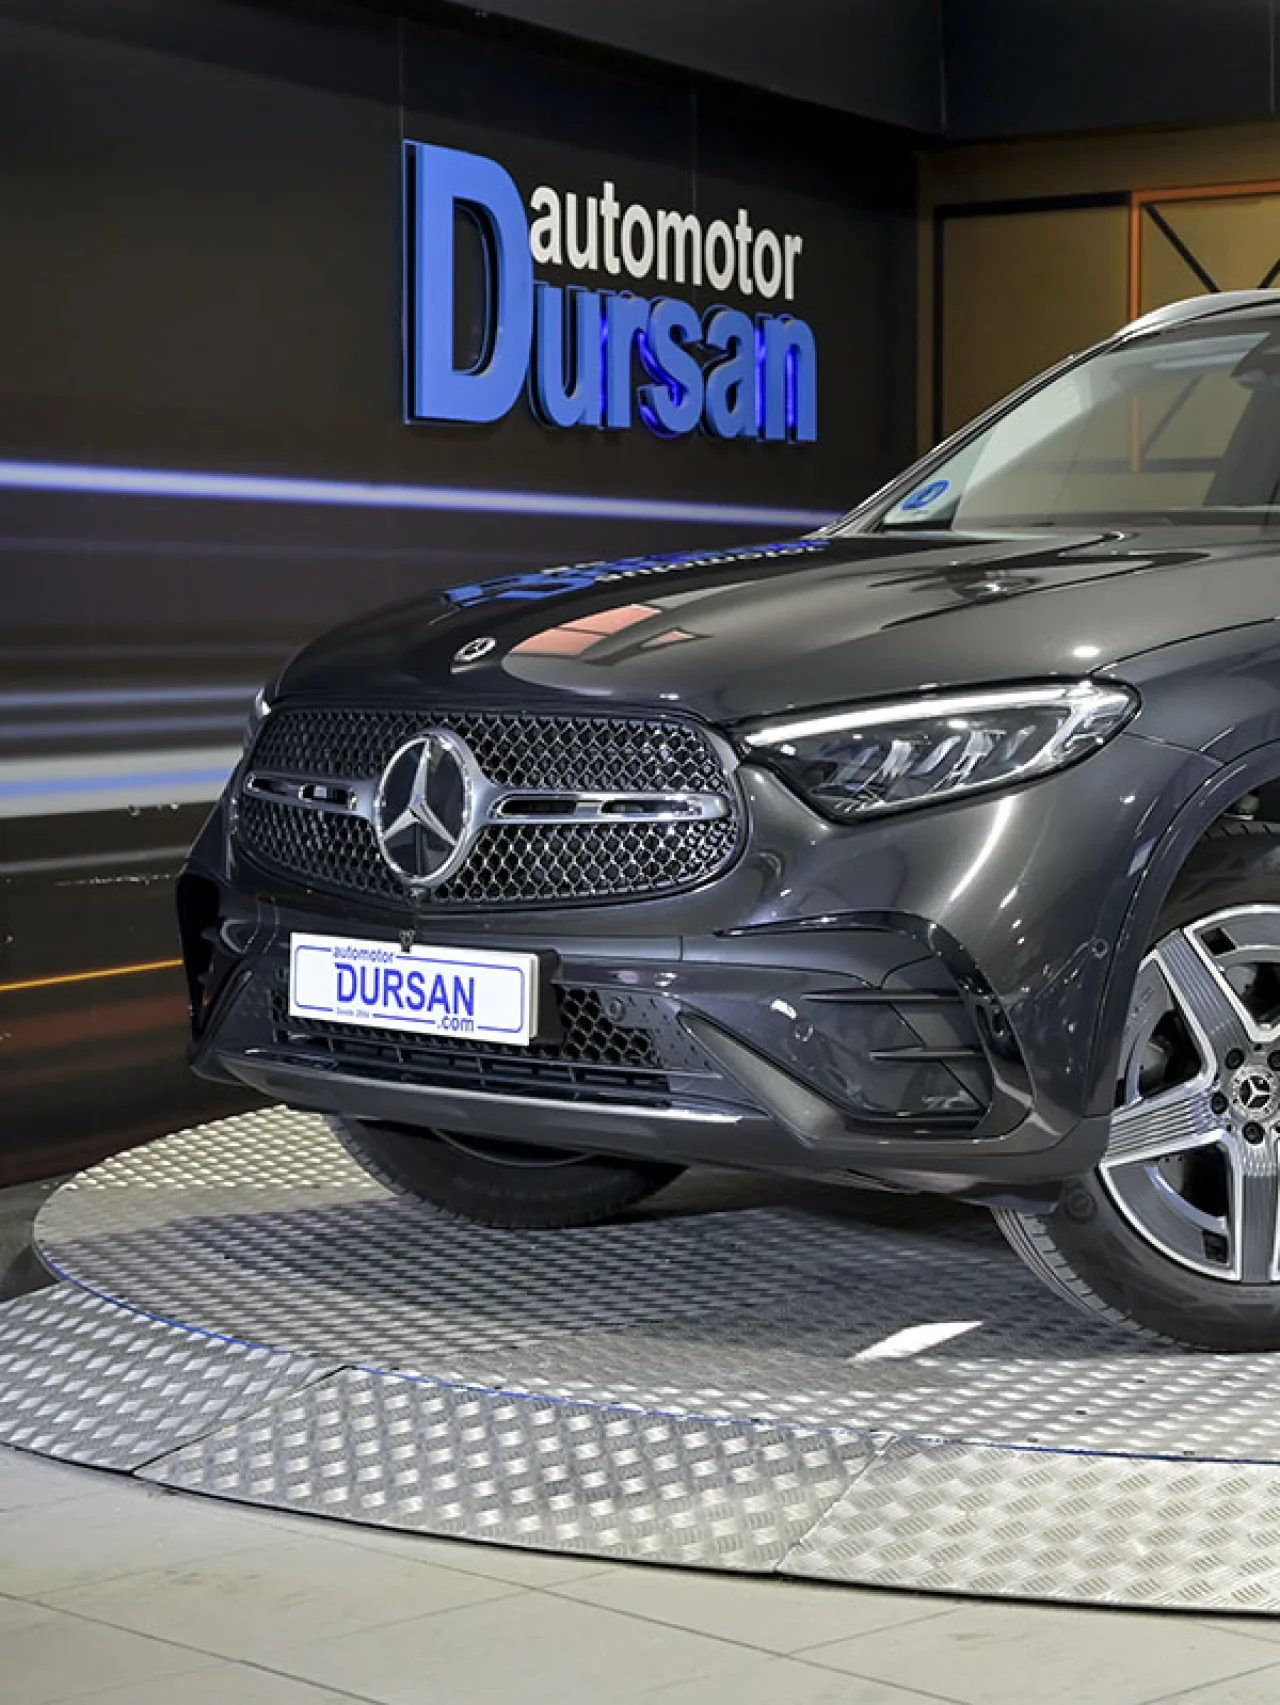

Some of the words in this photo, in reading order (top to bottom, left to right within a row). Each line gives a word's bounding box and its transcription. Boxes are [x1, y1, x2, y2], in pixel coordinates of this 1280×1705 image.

[530, 181, 802, 300] automotor
[403, 139, 817, 443] Dursan
[332, 946, 395, 963] automotor
[335, 962, 475, 1016] DURSAN
[437, 1015, 475, 1032] .com
